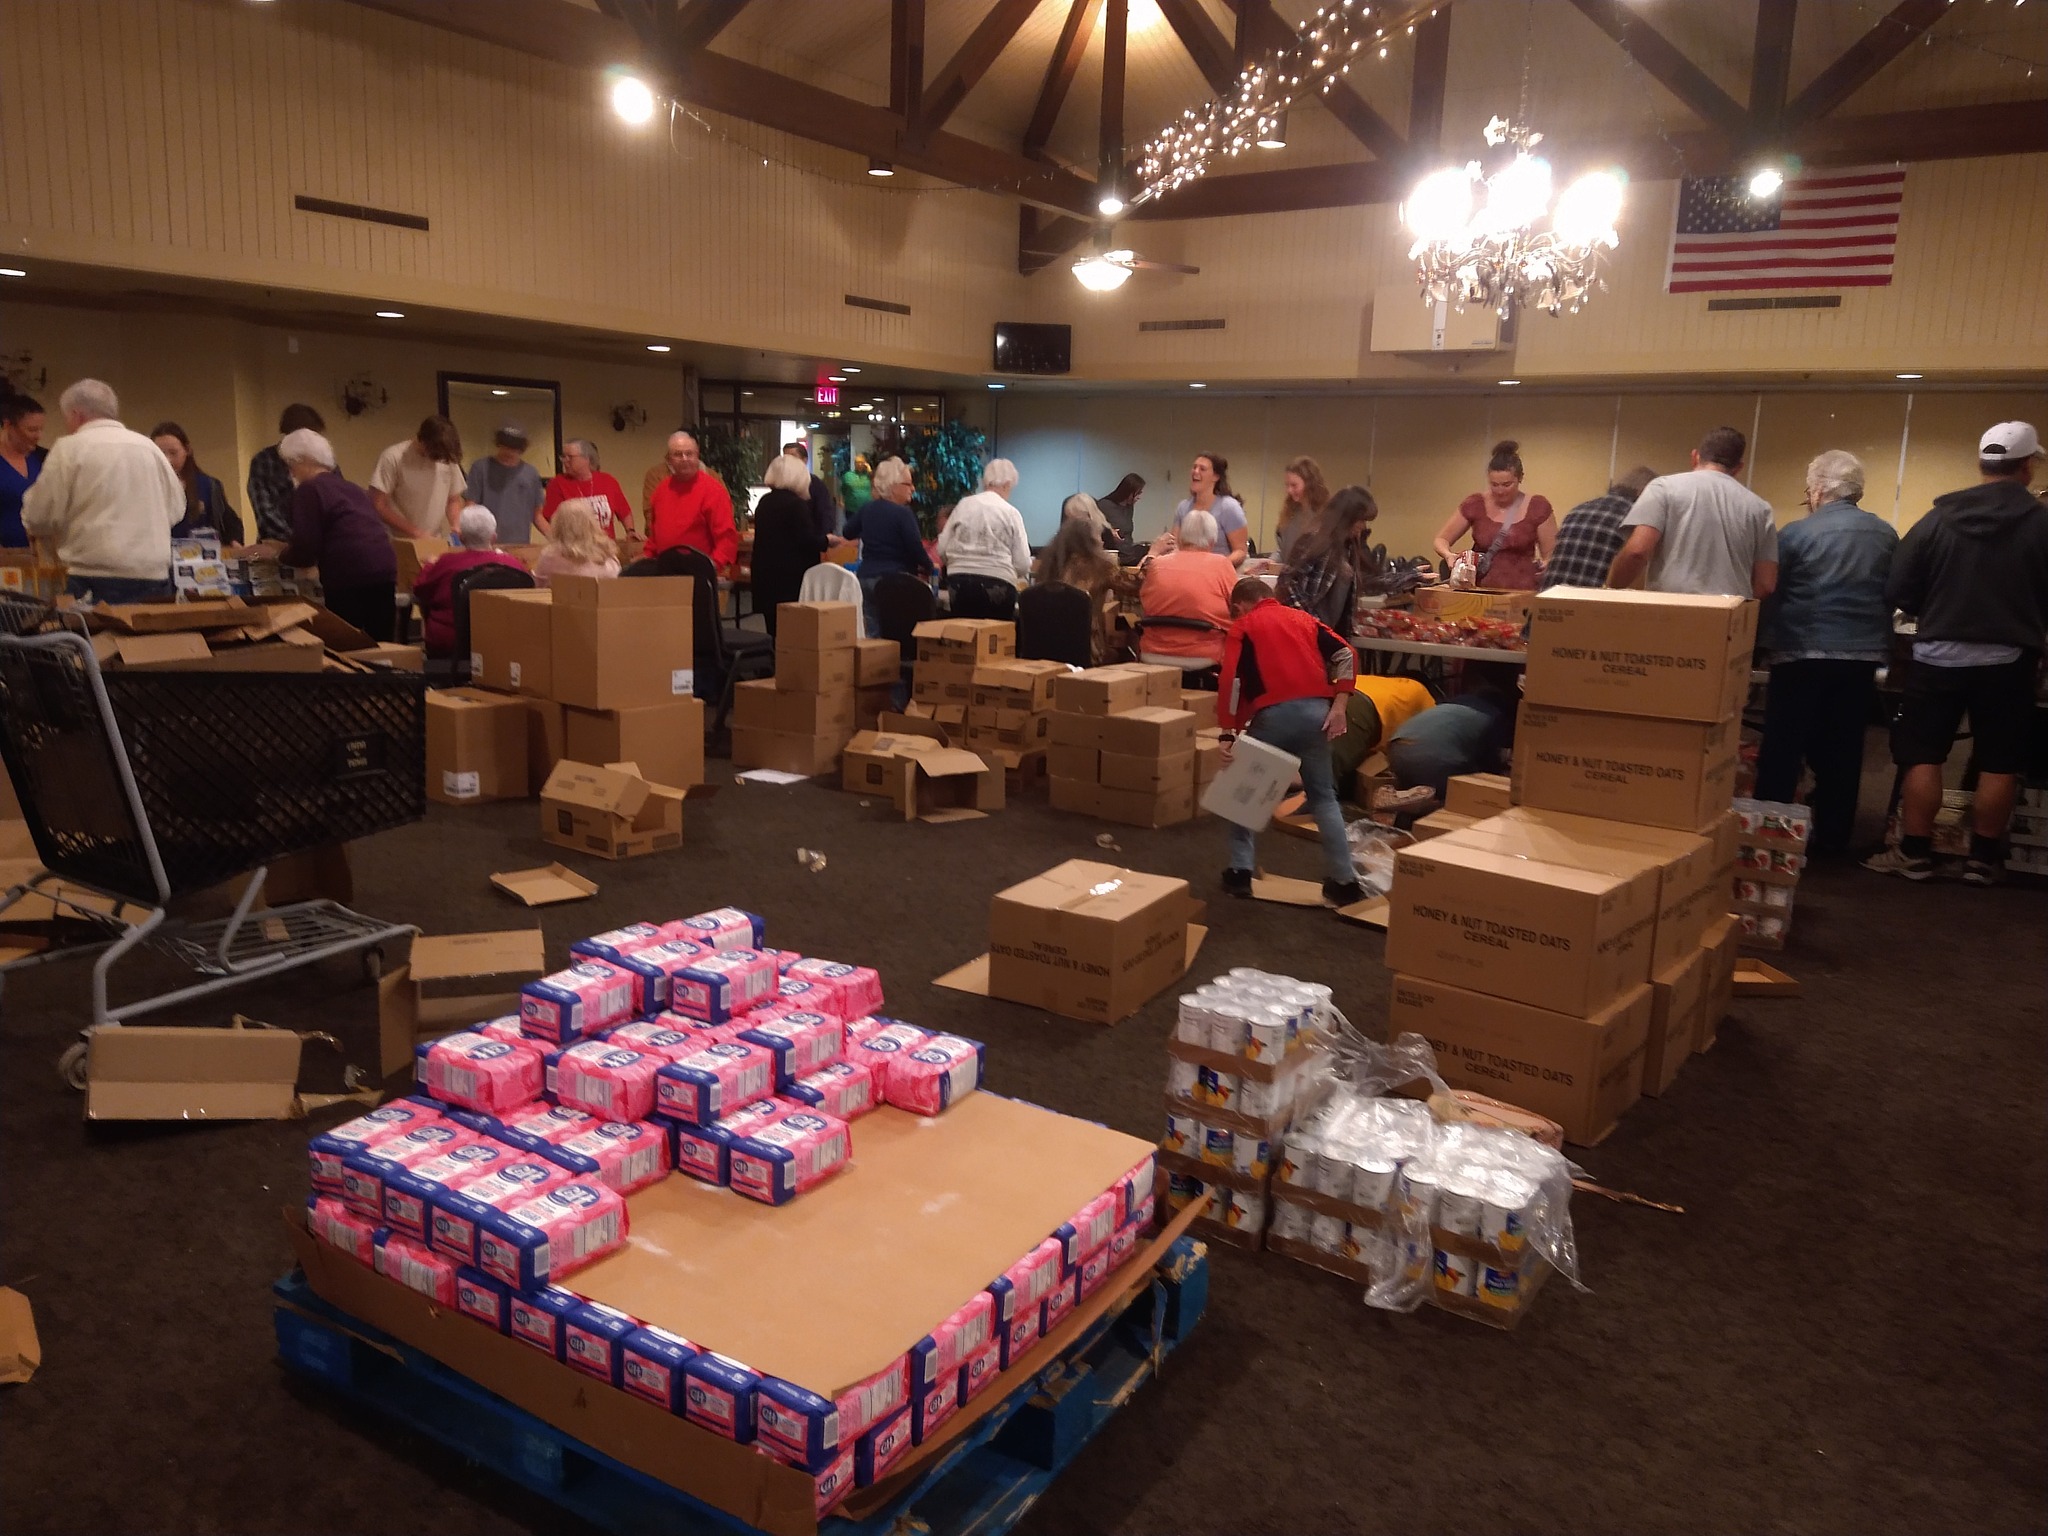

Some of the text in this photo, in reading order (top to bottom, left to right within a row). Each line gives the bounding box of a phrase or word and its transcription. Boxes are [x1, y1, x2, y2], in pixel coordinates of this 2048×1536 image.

[818, 387, 837, 403] EXIT
[1551, 647, 1706, 671] HONEY & NUT TOASTED OATS
[1602, 664, 1648, 677] CEREAL
[1536, 752, 1685, 781] HONEY & NUT TOASTED OATS
[1585, 770, 1630, 784] CEREAL
[1412, 903, 1571, 952] HONEY & NUT TOASTED OATS
[1464, 930, 1511, 950] CEREAL
[1451, 1044, 1459, 1056] &
[1462, 1046, 1485, 1062] NUT
[1486, 1053, 1539, 1078] TOASTED
[1541, 1068, 1573, 1087] OATS
[1465, 1062, 1513, 1084] CEREAL
